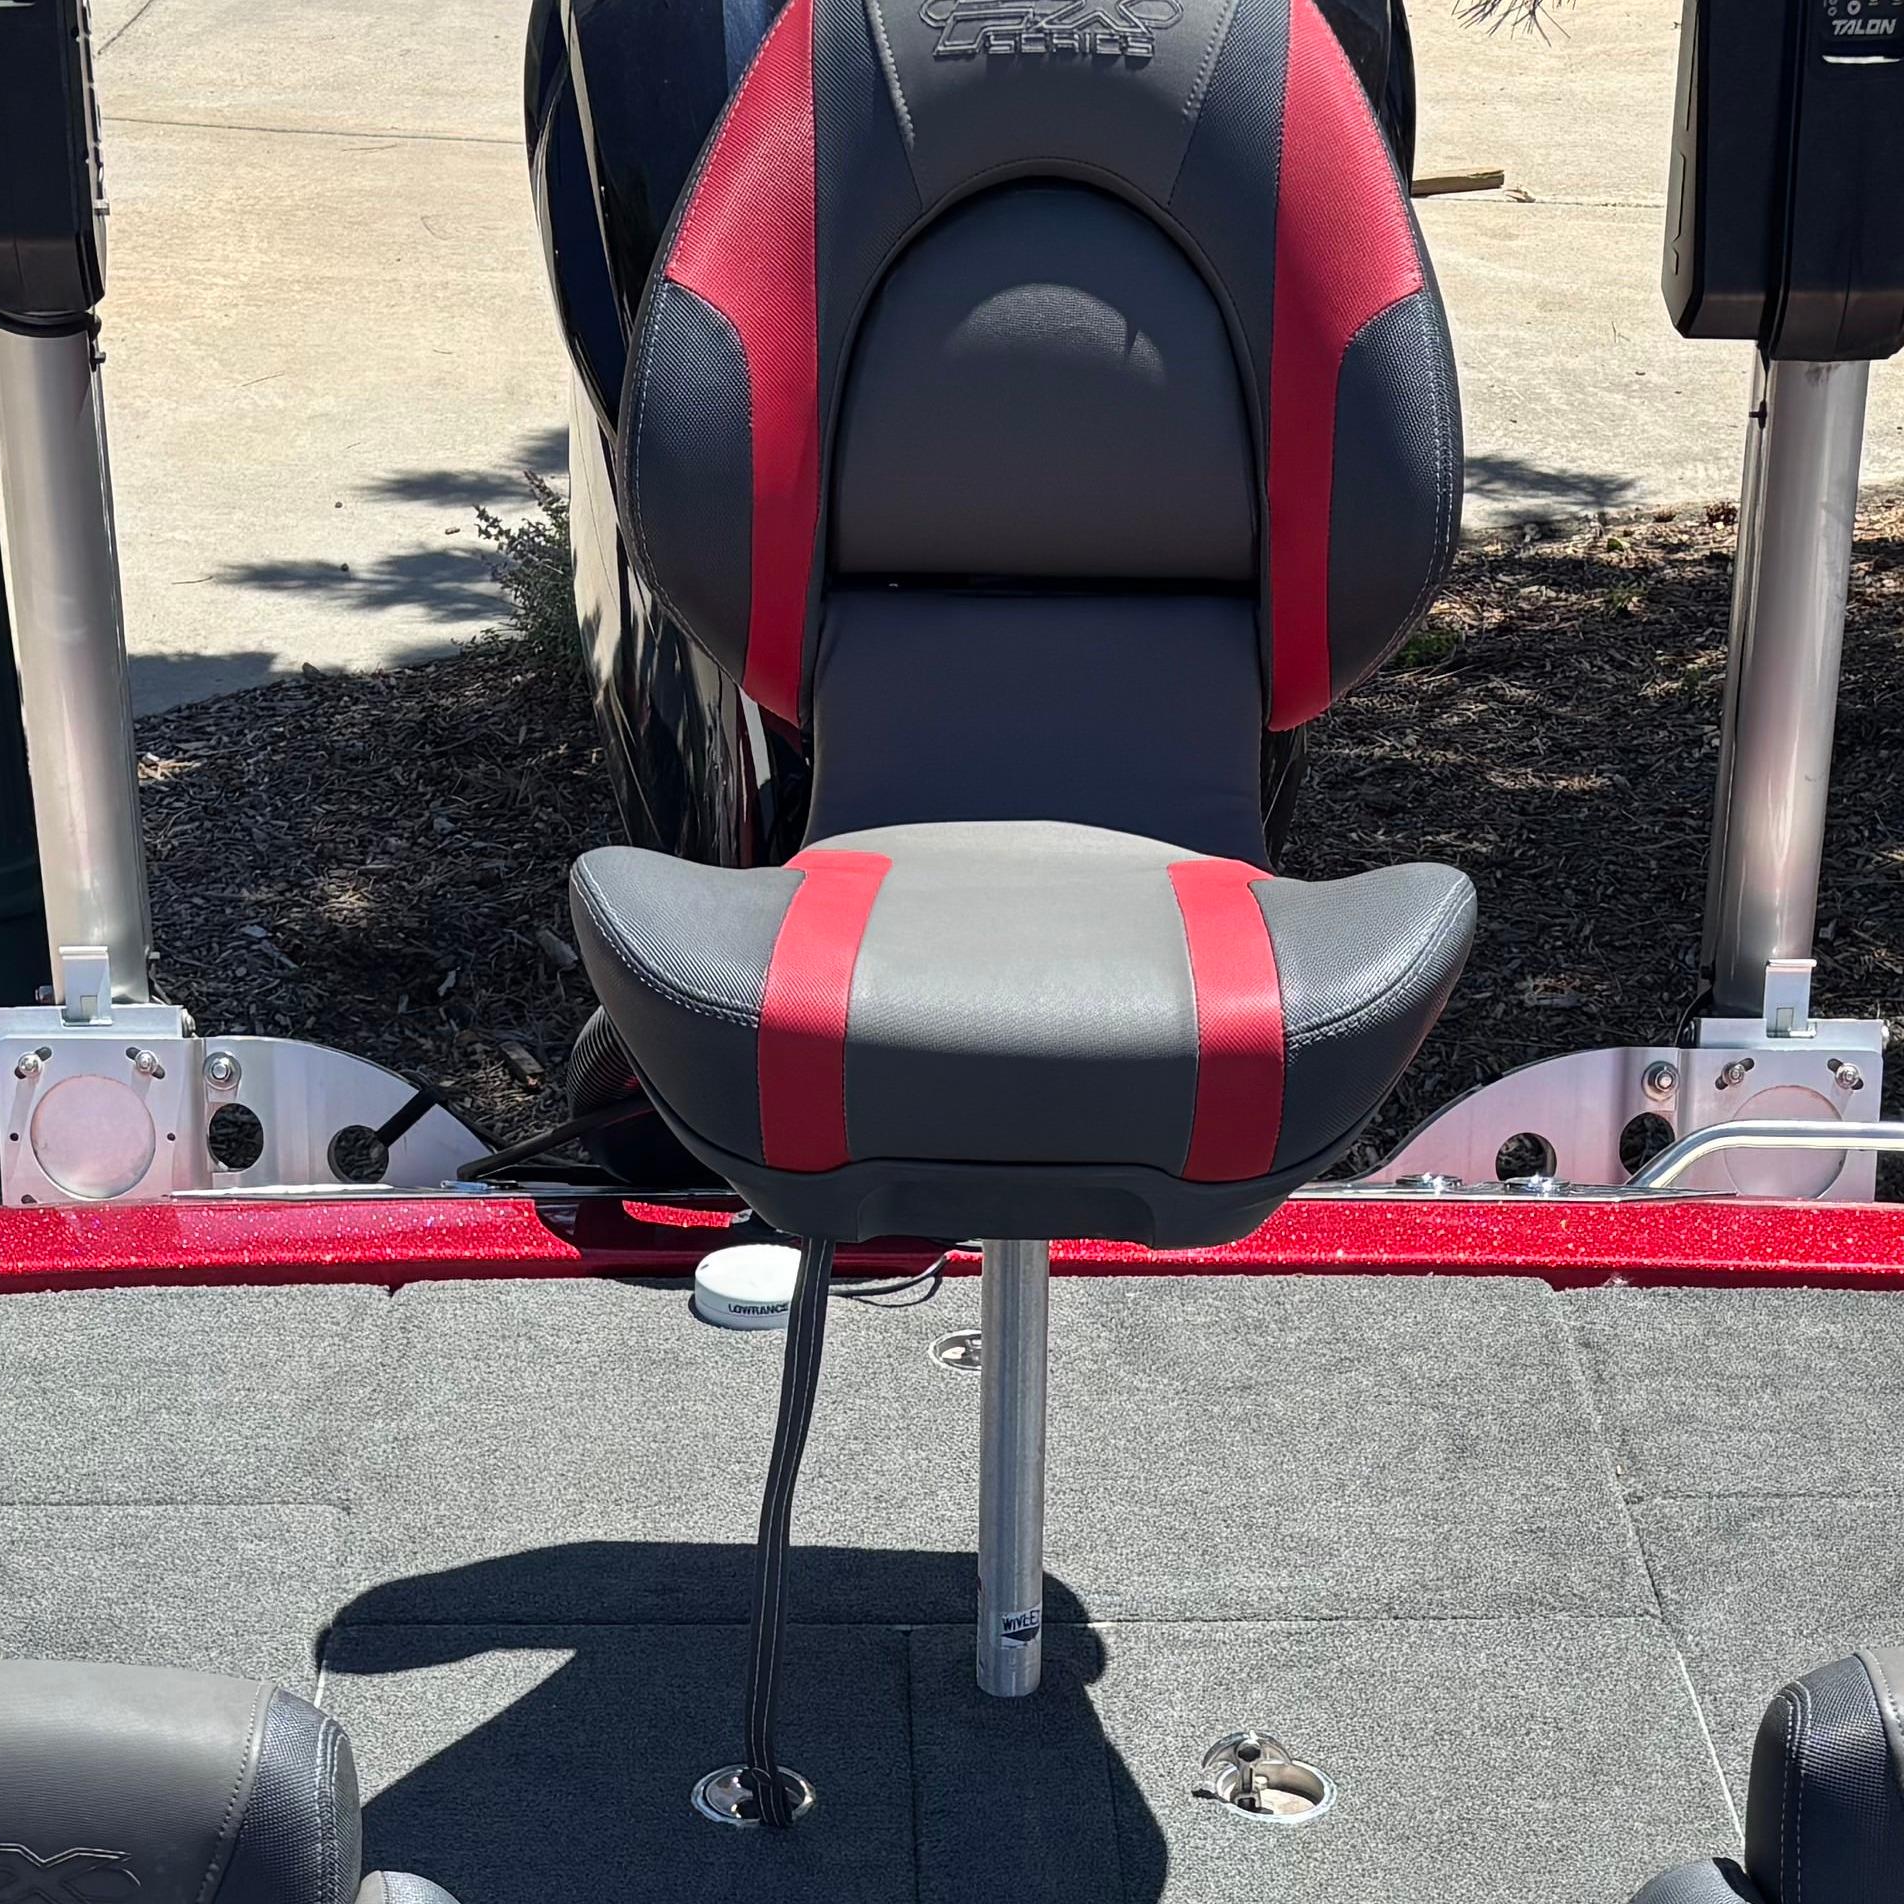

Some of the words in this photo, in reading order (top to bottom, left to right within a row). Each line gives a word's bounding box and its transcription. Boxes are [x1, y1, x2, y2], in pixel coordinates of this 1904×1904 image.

[1832, 19, 1897, 35] TALON
[985, 32, 1154, 57] SERIES
[728, 1302, 789, 1315] LOWRANCE
